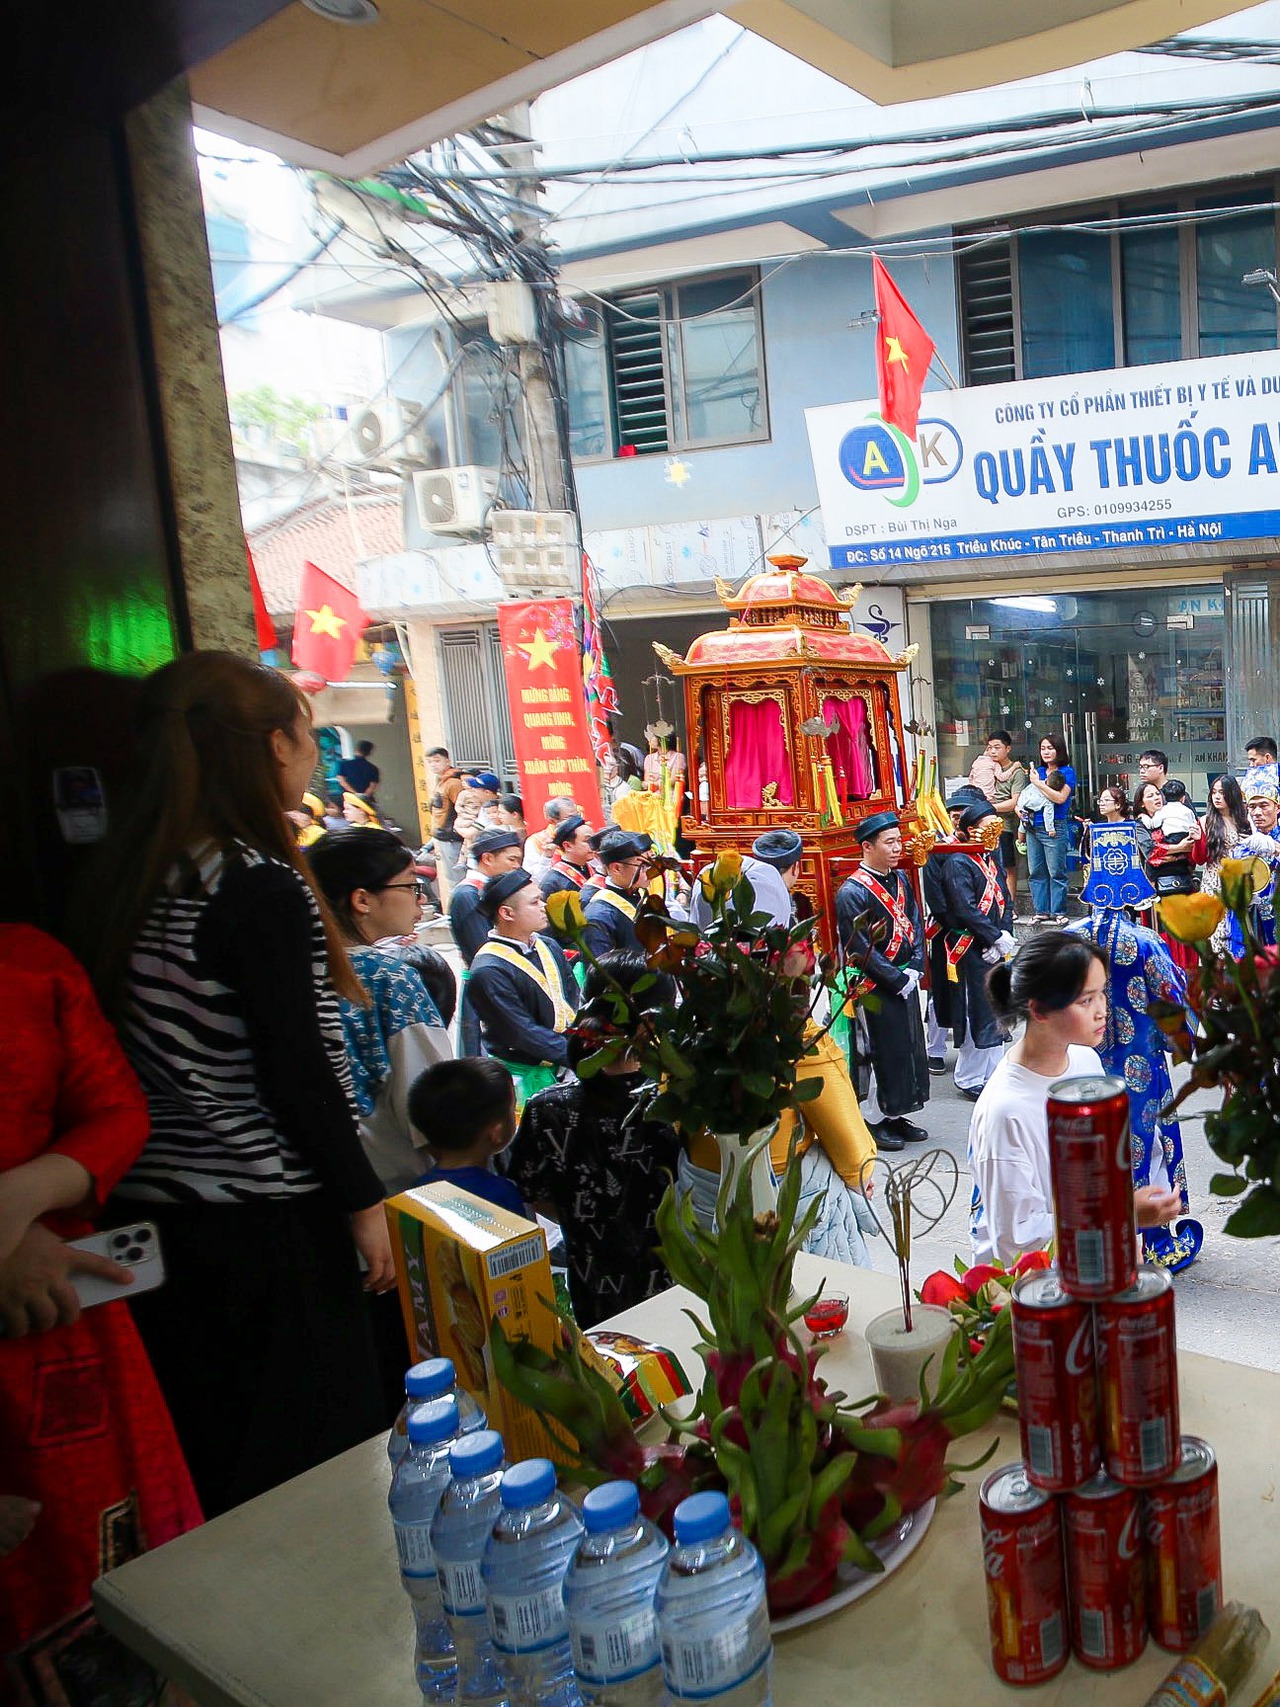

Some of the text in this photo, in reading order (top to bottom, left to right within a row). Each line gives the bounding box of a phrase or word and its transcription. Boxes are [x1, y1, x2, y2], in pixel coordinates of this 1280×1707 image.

[995, 403, 1035, 424] CÔNG
[1038, 401, 1055, 418] TY
[1060, 391, 1080, 417] CỔ
[1084, 388, 1126, 414] PHẦN
[1130, 382, 1172, 409] THIẾT
[1177, 385, 1193, 407] BỊ
[1198, 383, 1207, 401] Y
[1212, 375, 1231, 399] TẾ
[1235, 375, 1256, 397] VÀ
[863, 440, 890, 475] A
[919, 431, 948, 467] K
[973, 428, 1076, 504] QUẦY
[1090, 410, 1232, 489] THUỐC
[1057, 499, 1172, 519] GPS: 0109934255
[845, 524, 877, 536] DSPT
[888, 520, 908, 533] Bùi
[912, 518, 930, 532] Thị
[846, 550, 868, 563] ĐC:
[870, 546, 886, 560] Số
[888, 547, 901, 559] 14
[904, 545, 928, 561] Ngõ
[930, 544, 951, 556] 215
[957, 538, 987, 554] Triều
[991, 537, 1022, 552] Khúc
[1032, 534, 1056, 549] Tân
[1059, 530, 1091, 547] Triều
[1102, 528, 1144, 544] Thanh
[1147, 526, 1165, 540] Trì
[1177, 520, 1196, 538] Hà
[1199, 521, 1223, 537] Nội
[524, 713, 553, 728] QUANG
[523, 758, 549, 775] XUÂN
[1207, 751, 1228, 763] KHAN
